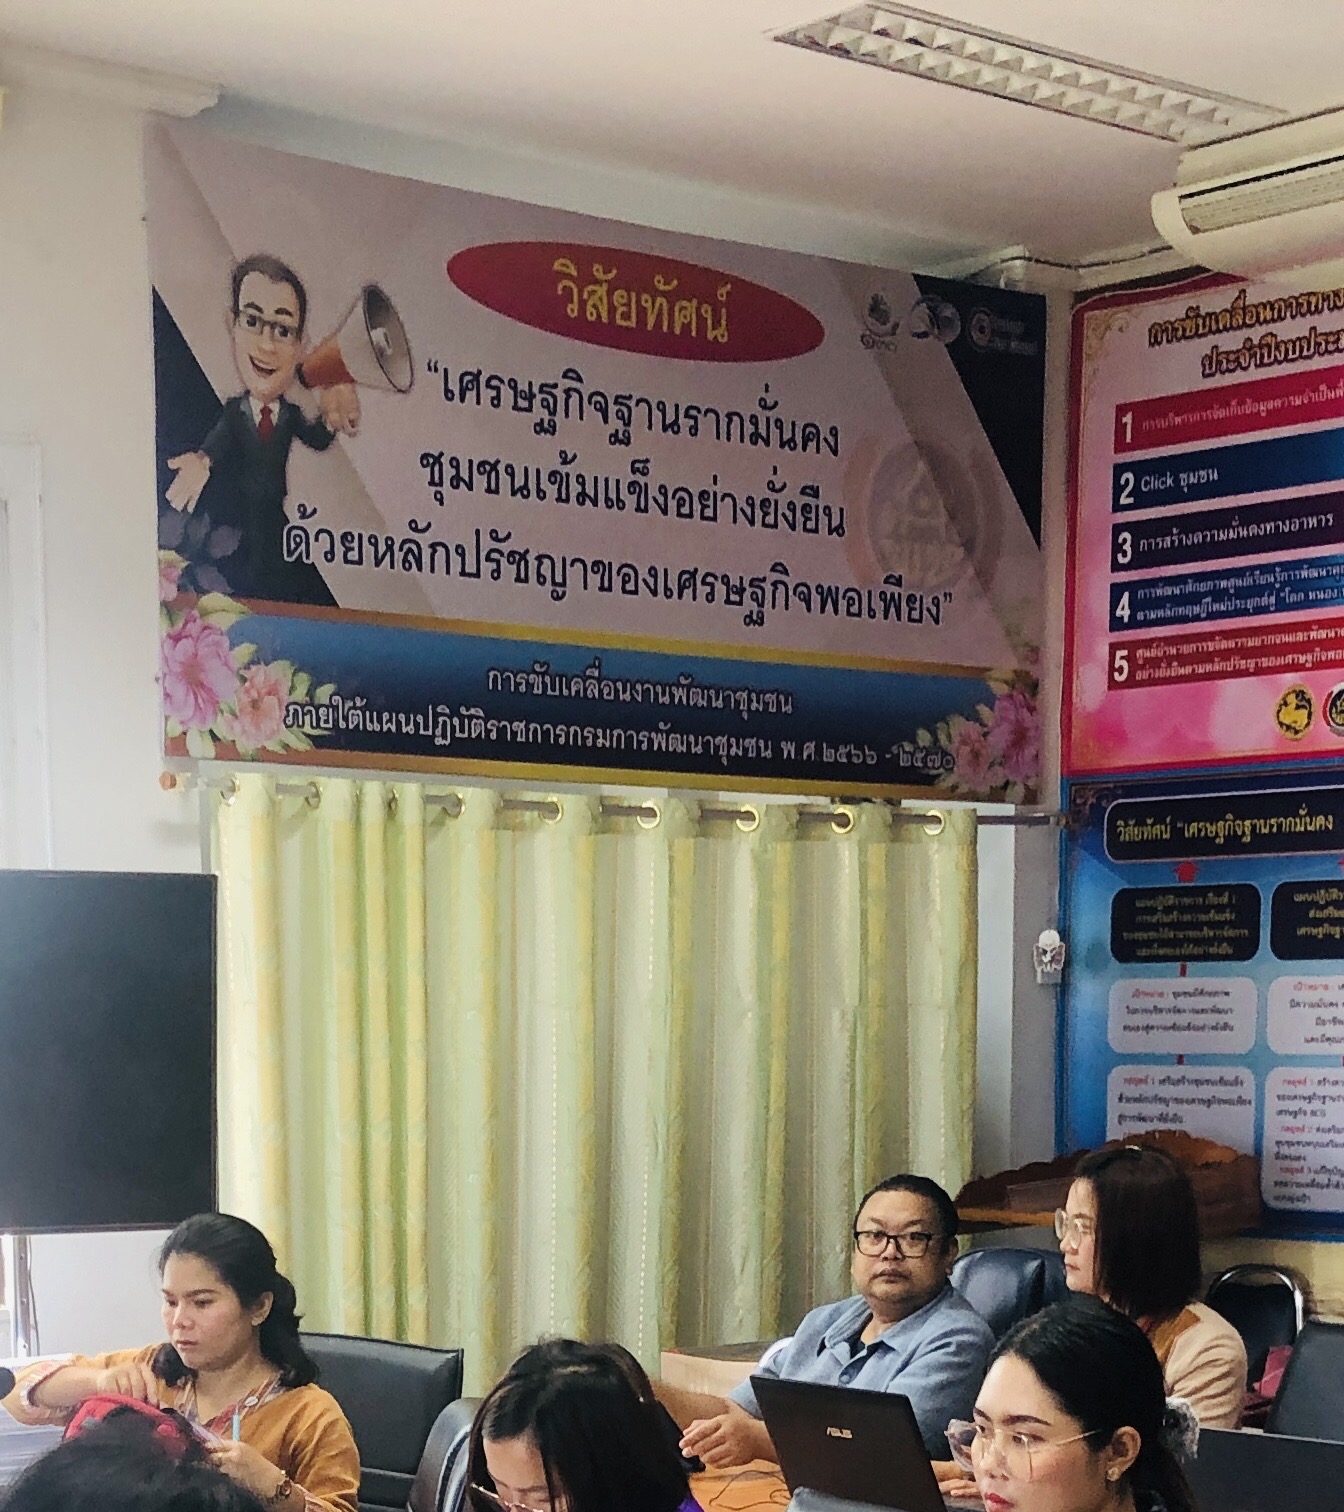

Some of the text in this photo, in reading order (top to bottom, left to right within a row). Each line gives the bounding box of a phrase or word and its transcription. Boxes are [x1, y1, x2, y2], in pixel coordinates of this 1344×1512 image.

[552, 257, 732, 345] วิสัยทัศน์
[426, 359, 840, 457] “เศรษฐกิจฐานรากมั่นคง
[1121, 410, 1133, 443] 1
[419, 450, 846, 539] ชุมชนเข้มแข็งอย่างยั่งยืน
[1119, 467, 1218, 505] 2 Click ชุมชน
[1117, 514, 1334, 564] 3 การสร้างความมั่นคงทางอาหาร
[284, 503, 954, 628] ด้วยหลักปรัชญาของเศรษฐกิจพอเพียง”
[1115, 591, 1131, 623] 4
[487, 657, 794, 720] การขับเคลื่อนงานพัฒนาชุมชน
[1113, 650, 1129, 682] 5
[1116, 815, 1171, 843] วิสัยทัศน์
